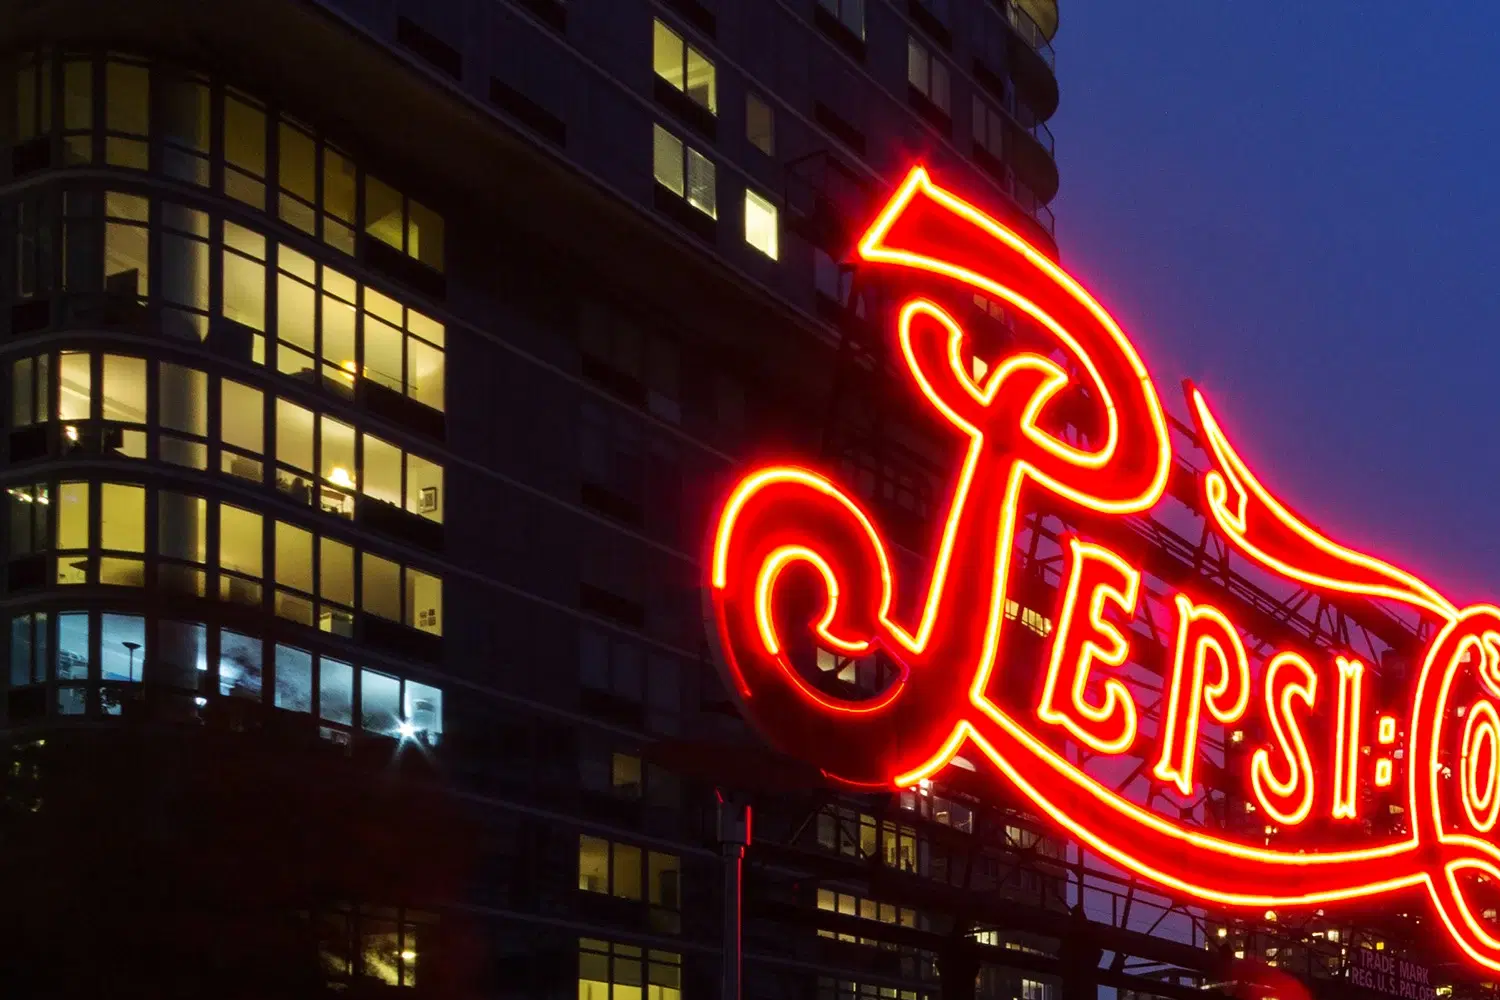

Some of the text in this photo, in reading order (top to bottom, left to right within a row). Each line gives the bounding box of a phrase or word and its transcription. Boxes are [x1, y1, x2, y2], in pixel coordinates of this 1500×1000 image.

[1351, 966, 1376, 991] REG.
[1360, 948, 1430, 985] TRADE MARK
